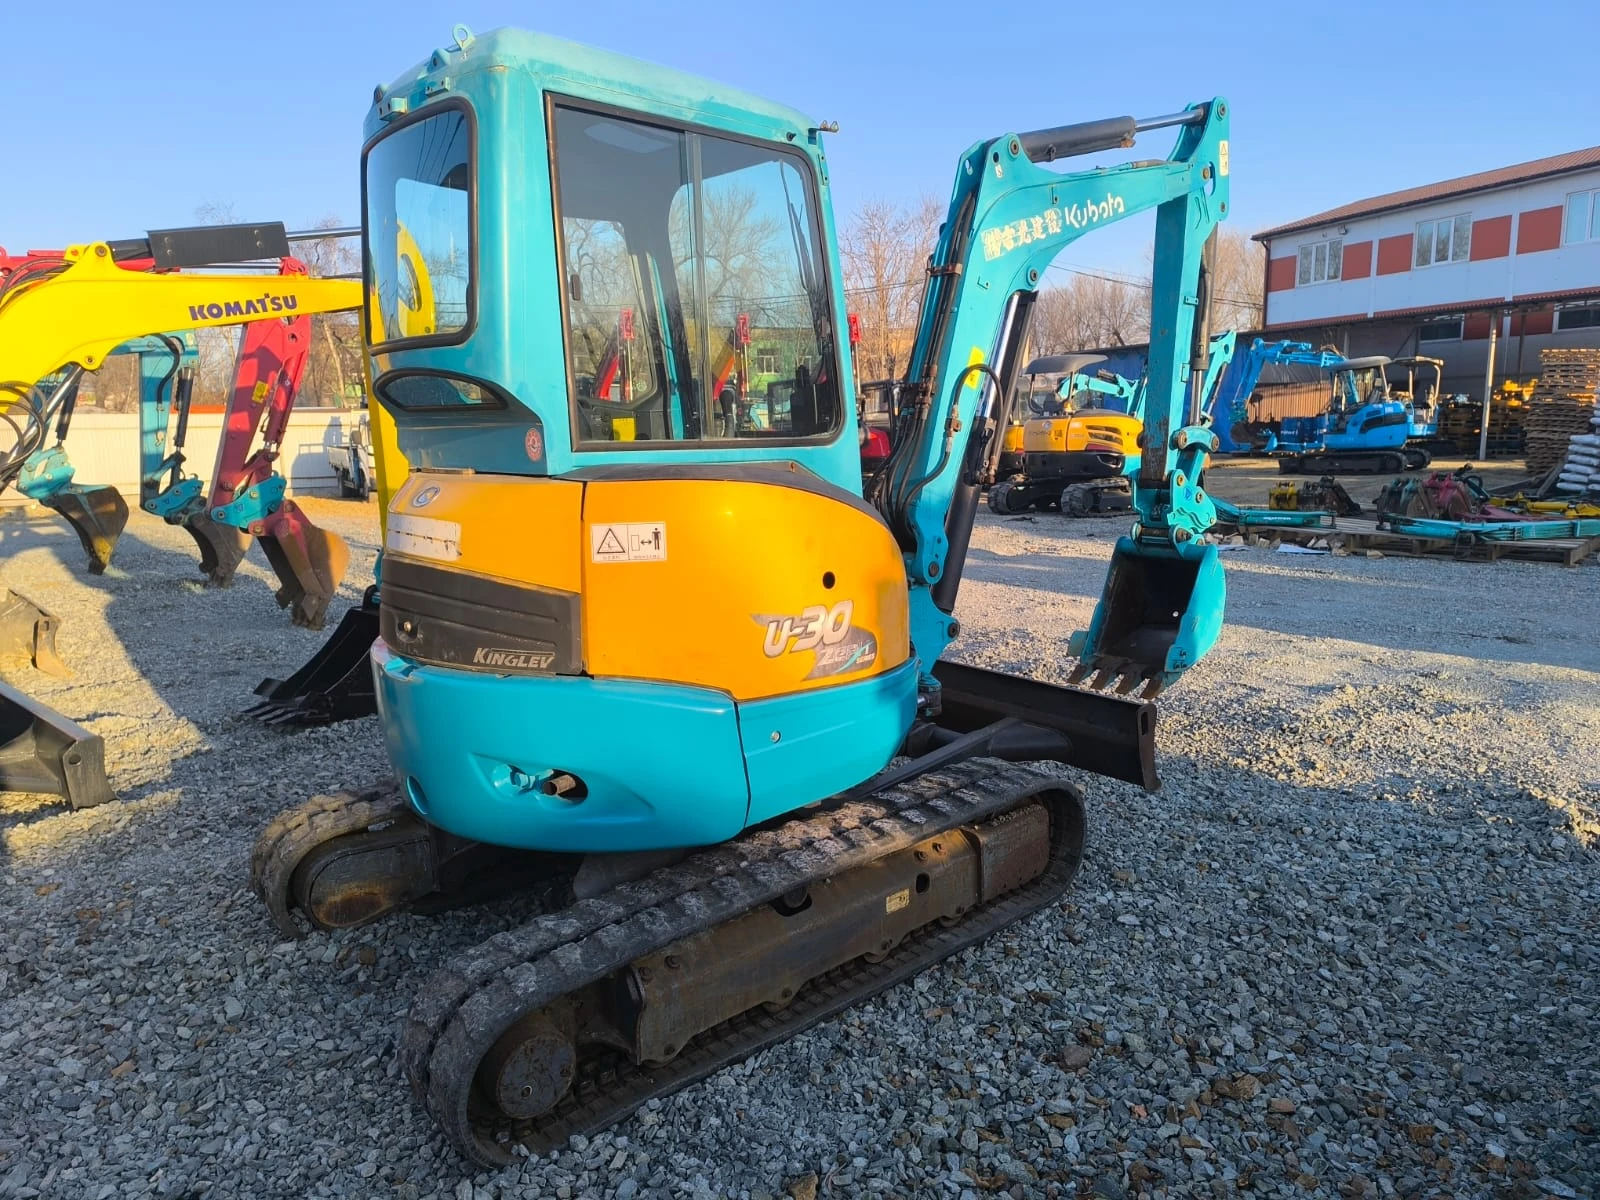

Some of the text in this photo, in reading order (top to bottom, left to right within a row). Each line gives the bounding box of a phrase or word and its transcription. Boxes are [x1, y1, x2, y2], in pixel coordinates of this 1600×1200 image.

[1065, 192, 1125, 228] Kubota
[188, 293, 298, 321] KOMATSU
[763, 599, 854, 658] U-30
